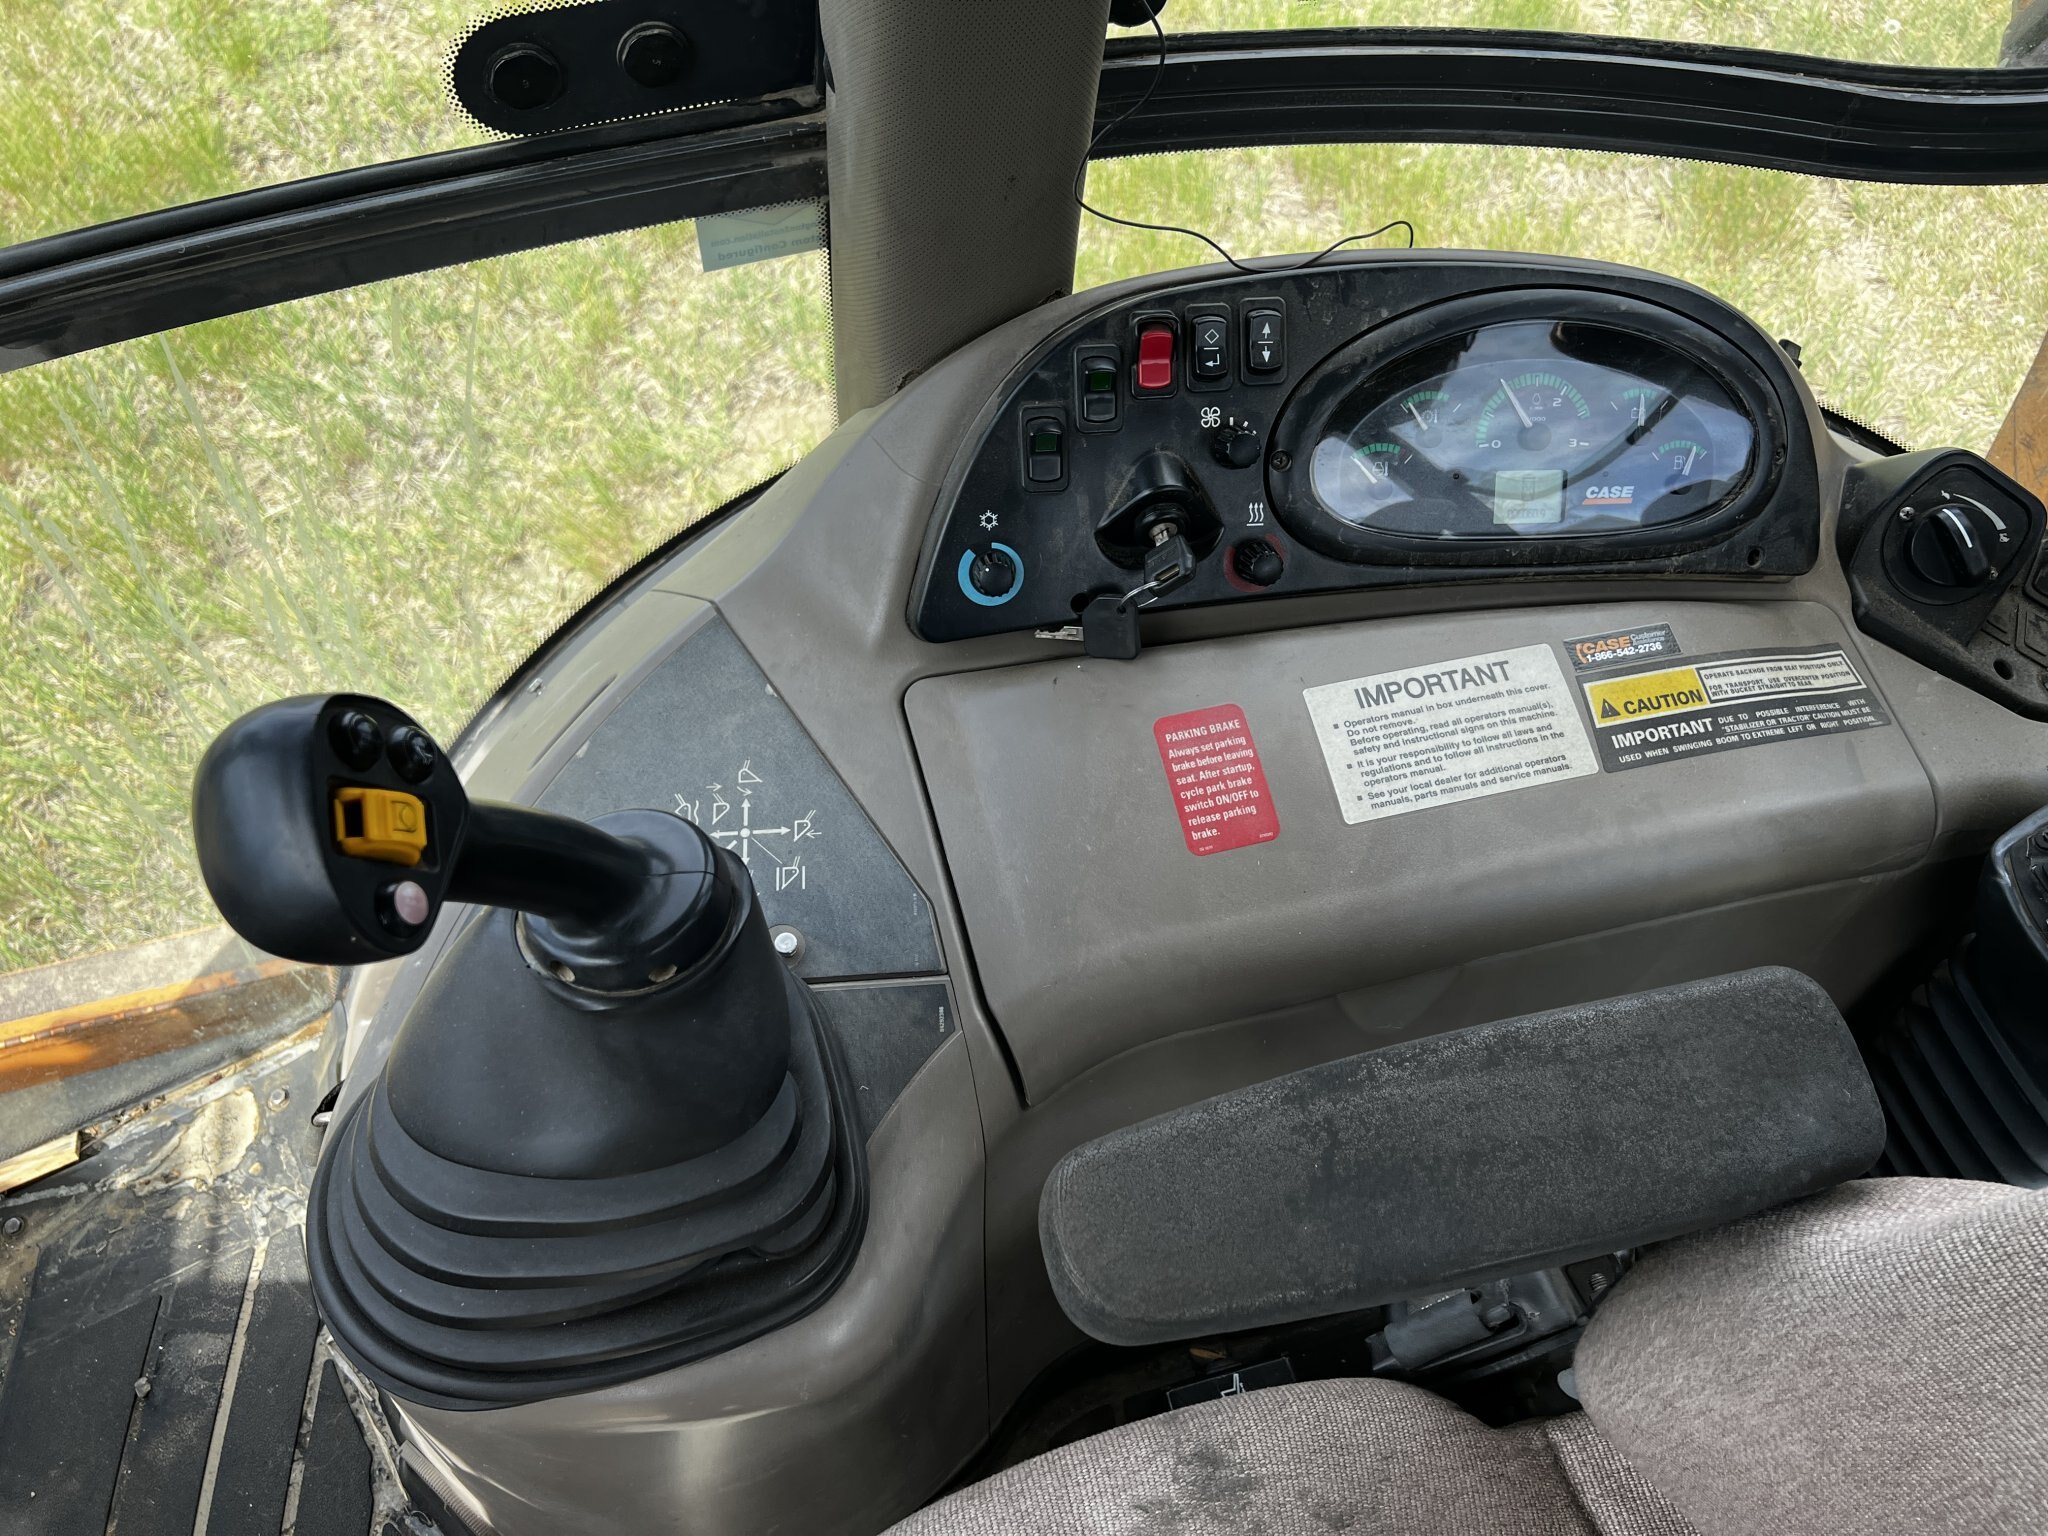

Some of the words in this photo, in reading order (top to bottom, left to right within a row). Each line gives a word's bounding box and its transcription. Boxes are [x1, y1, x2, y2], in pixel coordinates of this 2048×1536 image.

[1552, 397, 1562, 407] 2
[1491, 439, 1502, 449] 0
[1585, 485, 1634, 500] CASE
[1582, 635, 1631, 654] CASE
[1630, 630, 1666, 641] Customer
[1586, 641, 1663, 663] 1-866-542-2736
[1354, 660, 1510, 709] IMPORTANT
[1704, 670, 1735, 680] OPERATE
[1735, 667, 1765, 676] BACKHOE
[1783, 674, 1819, 682] OVERCENTER
[1821, 671, 1851, 680] POSITION
[1623, 688, 1704, 715] CAUTION
[1711, 689, 1729, 697] WITH
[1730, 686, 1756, 694] BUCKET
[1758, 682, 1788, 691] STRAIGHT
[1344, 713, 1389, 728] Operators
[1391, 706, 1424, 719] manual
[1425, 703, 1435, 712] in
[1436, 701, 1453, 710] box
[1455, 691, 1504, 706] underneath
[1506, 687, 1522, 697] this
[1525, 683, 1551, 693] cover.
[1717, 715, 1734, 724] DUE
[1738, 713, 1749, 721] TO
[1755, 707, 1789, 719] POSSIBLE
[1795, 702, 1840, 713] INTERFERENCE
[1848, 698, 1866, 706] WITH
[1766, 718, 1777, 726] OR
[1812, 710, 1841, 720] CAUTION
[1841, 708, 1861, 717] MUST
[1862, 706, 1871, 714] BE
[1165, 726, 1208, 743] PARKING
[1210, 719, 1241, 734] BRAKE
[1347, 728, 1360, 737] Do
[1362, 725, 1378, 735] not
[1379, 719, 1416, 731] remove.
[1350, 734, 1380, 746] Before
[1382, 725, 1429, 741] operating,
[1430, 719, 1450, 731] read
[1452, 717, 1463, 726] all
[1464, 709, 1506, 724] operators
[1353, 743, 1381, 756] safety
[1383, 740, 1400, 750] and
[1402, 728, 1458, 746] instructional
[1461, 723, 1485, 735] signs
[1487, 720, 1498, 729] on
[1500, 715, 1517, 726] this
[1518, 709, 1558, 723] machine.
[1611, 717, 1713, 749] IMPORTANT
[1168, 746, 1200, 759] Always
[1201, 742, 1214, 752] set
[1215, 735, 1247, 751] parking
[1357, 760, 1364, 769] It
[1366, 757, 1375, 767] is
[1376, 755, 1397, 767] your
[1399, 741, 1460, 760] responsibility
[1462, 739, 1472, 747] to
[1473, 733, 1500, 745] follow
[1502, 729, 1513, 739] all
[1514, 727, 1534, 737] laws
[1536, 722, 1553, 733] and
[1618, 752, 1642, 763] USED
[1645, 747, 1669, 758] WHEN
[1672, 739, 1713, 753] SWINGING
[1716, 735, 1739, 745] BOOM
[1741, 733, 1751, 741] TO
[1752, 728, 1785, 740] EXTREME
[1788, 725, 1803, 734] LEFT
[1806, 723, 1816, 731] OR
[1820, 720, 1839, 729] RIGHT
[1172, 760, 1196, 772] brake
[1197, 753, 1222, 767] before
[1224, 748, 1254, 762] leaving
[1360, 762, 1412, 778] regulations
[1414, 757, 1431, 767] and
[1433, 755, 1443, 763] to
[1444, 748, 1471, 761] follow
[1473, 746, 1485, 755] all
[1486, 735, 1539, 752] instructions
[1540, 733, 1549, 742] in
[1550, 730, 1565, 740] the
[1176, 774, 1198, 786] seat.
[1199, 768, 1221, 781] After
[1180, 786, 1204, 799] cycle
[1206, 782, 1226, 794] park
[1227, 776, 1252, 789] brake
[1363, 772, 1408, 787] operators
[1410, 765, 1446, 778] manual.
[1367, 790, 1385, 800] See
[1387, 786, 1408, 797] your
[1410, 780, 1432, 791] local
[1434, 773, 1462, 786] dealer
[1464, 770, 1477, 779] for
[1479, 761, 1523, 777] additional
[1524, 753, 1567, 769] operators
[1371, 796, 1413, 810] manuals,
[1414, 789, 1438, 802] parts
[1440, 781, 1478, 796] manuals
[1480, 776, 1498, 787] and
[1499, 771, 1531, 783] service
[1533, 762, 1572, 777] manuals.
[1184, 799, 1214, 813] switch
[1216, 791, 1248, 805] ON/OFF
[1249, 789, 1259, 799] to
[1188, 813, 1221, 827] release
[1223, 804, 1257, 821] parking
[1192, 829, 1220, 841] brake.
